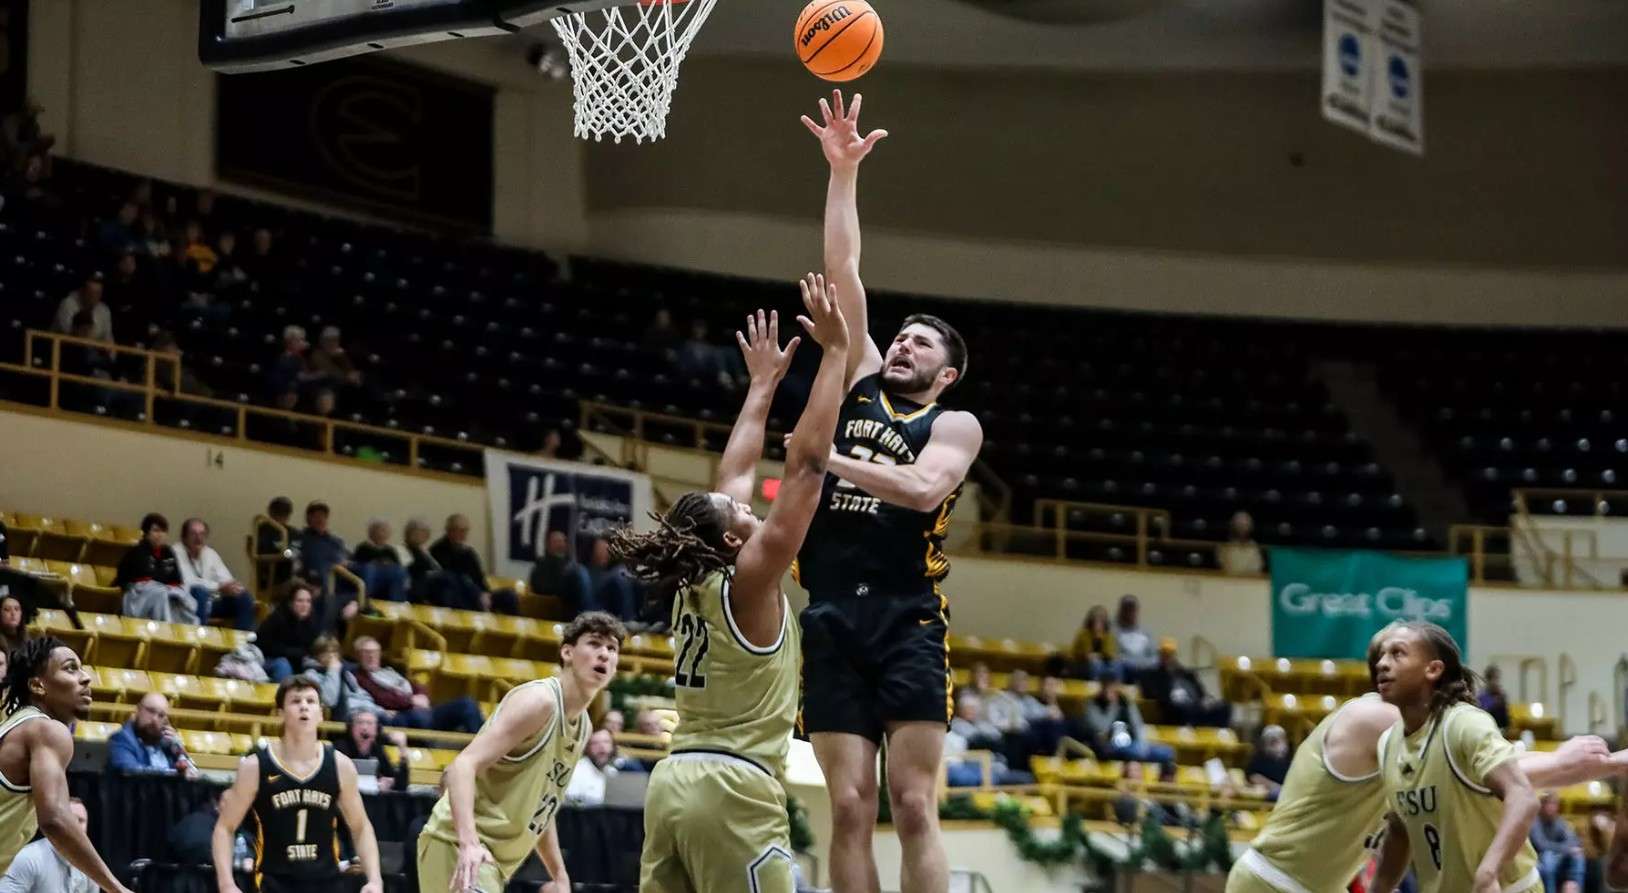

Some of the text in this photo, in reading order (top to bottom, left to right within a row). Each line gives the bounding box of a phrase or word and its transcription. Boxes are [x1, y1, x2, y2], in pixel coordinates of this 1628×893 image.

[801, 6, 853, 47] Wilson
[845, 420, 883, 438] FORT
[206, 448, 225, 470] 14
[830, 493, 880, 514] STATE
[1280, 583, 1452, 622] Great Clips
[675, 613, 708, 688] 22
[272, 789, 332, 809] FORT HAYS
[296, 809, 308, 842] 1
[287, 844, 317, 859] STATE
[1424, 824, 1441, 871] 8
